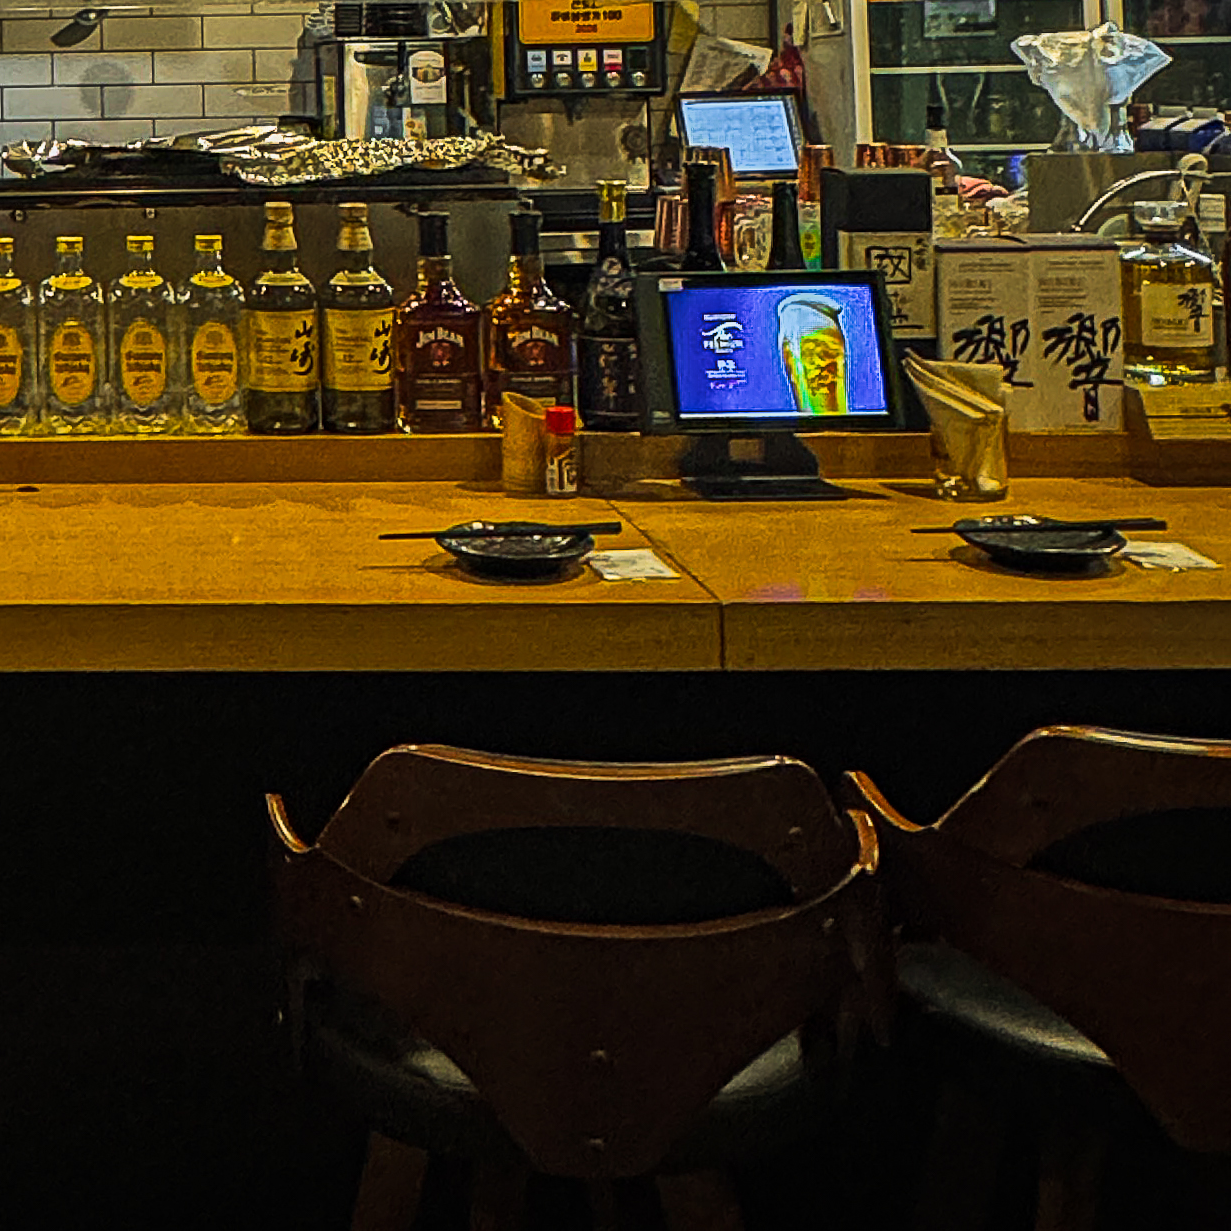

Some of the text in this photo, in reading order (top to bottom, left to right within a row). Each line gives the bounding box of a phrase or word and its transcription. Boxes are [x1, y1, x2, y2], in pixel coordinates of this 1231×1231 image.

[415, 326, 465, 349] JIM BEAM
[531, 325, 560, 347] BEAM
[1041, 312, 1124, 422] 響
